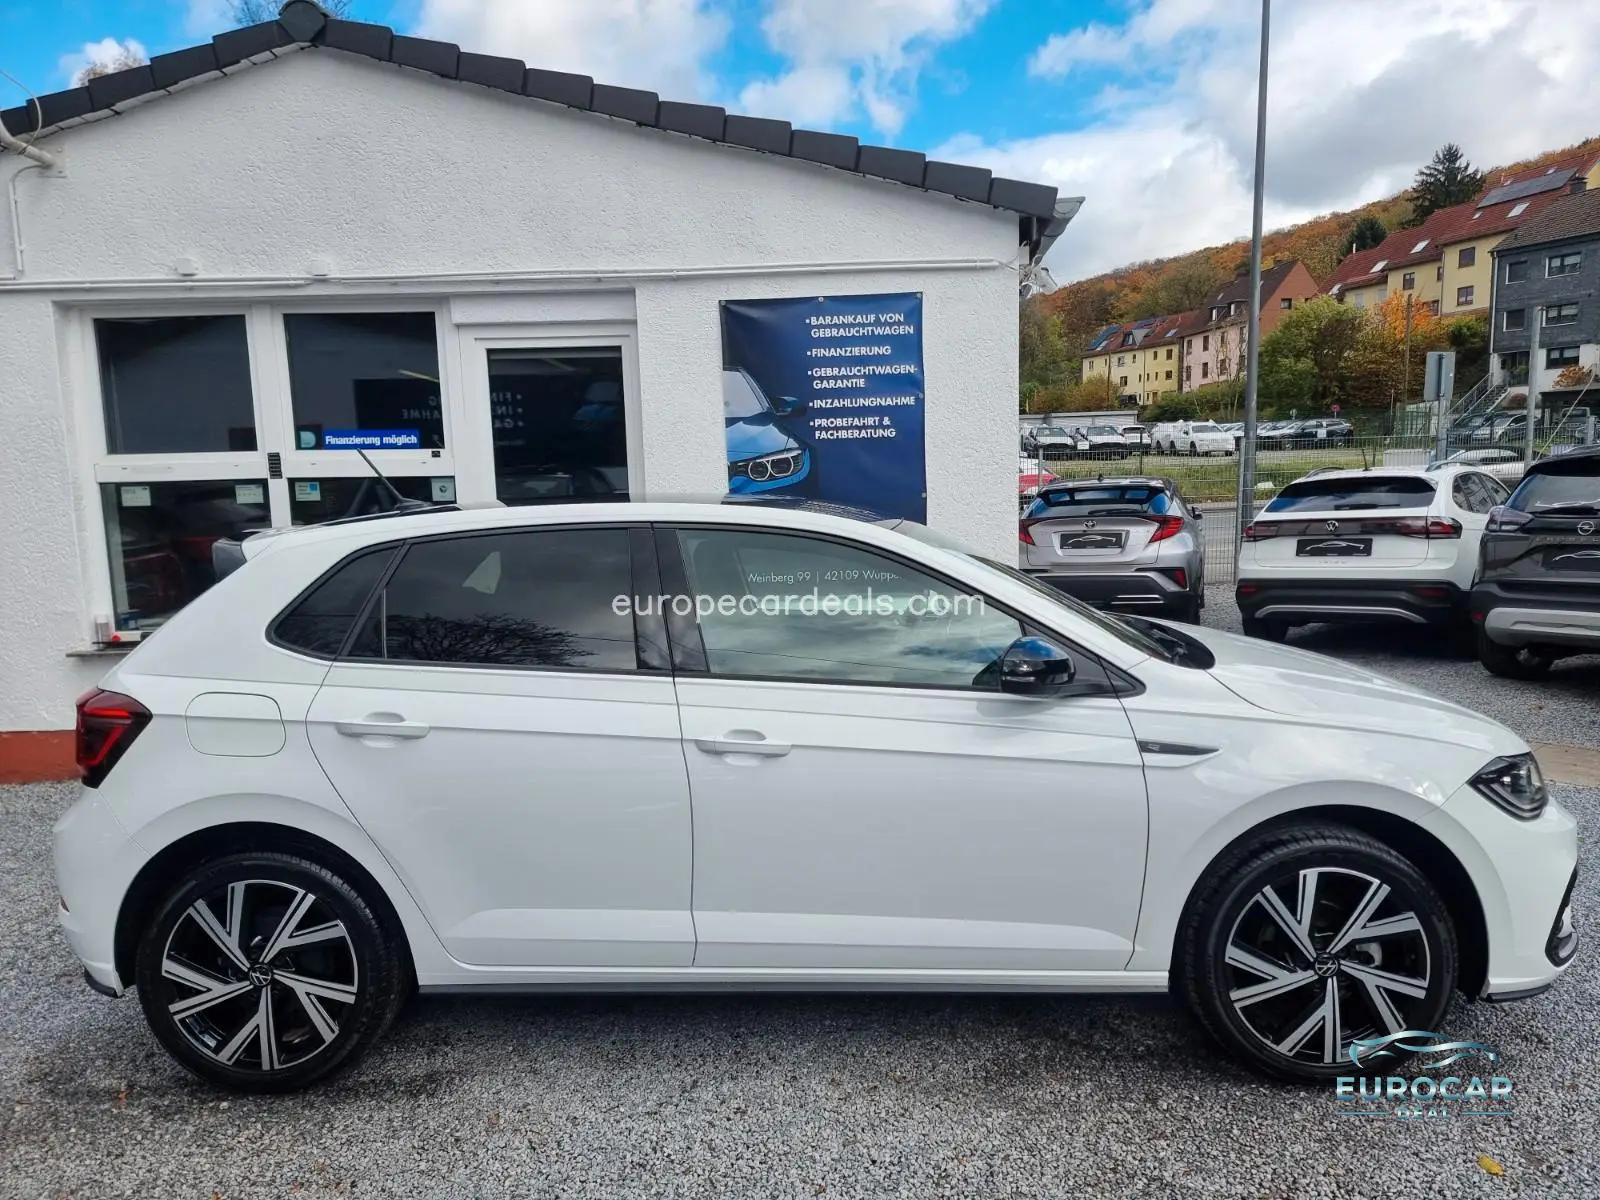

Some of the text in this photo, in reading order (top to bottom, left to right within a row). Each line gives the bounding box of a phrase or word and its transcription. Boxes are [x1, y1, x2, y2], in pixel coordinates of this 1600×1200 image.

[811, 313, 904, 325] BARANKAUF VON
[811, 325, 914, 338] GEBRAUCHTWAGEN
[812, 346, 892, 357] FINANZIERUNG
[813, 364, 918, 377] GEBRAUCHTWAGEN-
[813, 378, 866, 389] GARANTIE
[814, 396, 916, 408] INZAHLUNGNAHME
[814, 416, 891, 428] PROBEFAHRT &
[325, 435, 381, 446] Finanzierung
[383, 434, 418, 446] möglich
[815, 428, 896, 440] FACHBERATUNG
[748, 572, 794, 584] Weinberg
[797, 571, 811, 582] 99
[824, 570, 859, 581] 42109
